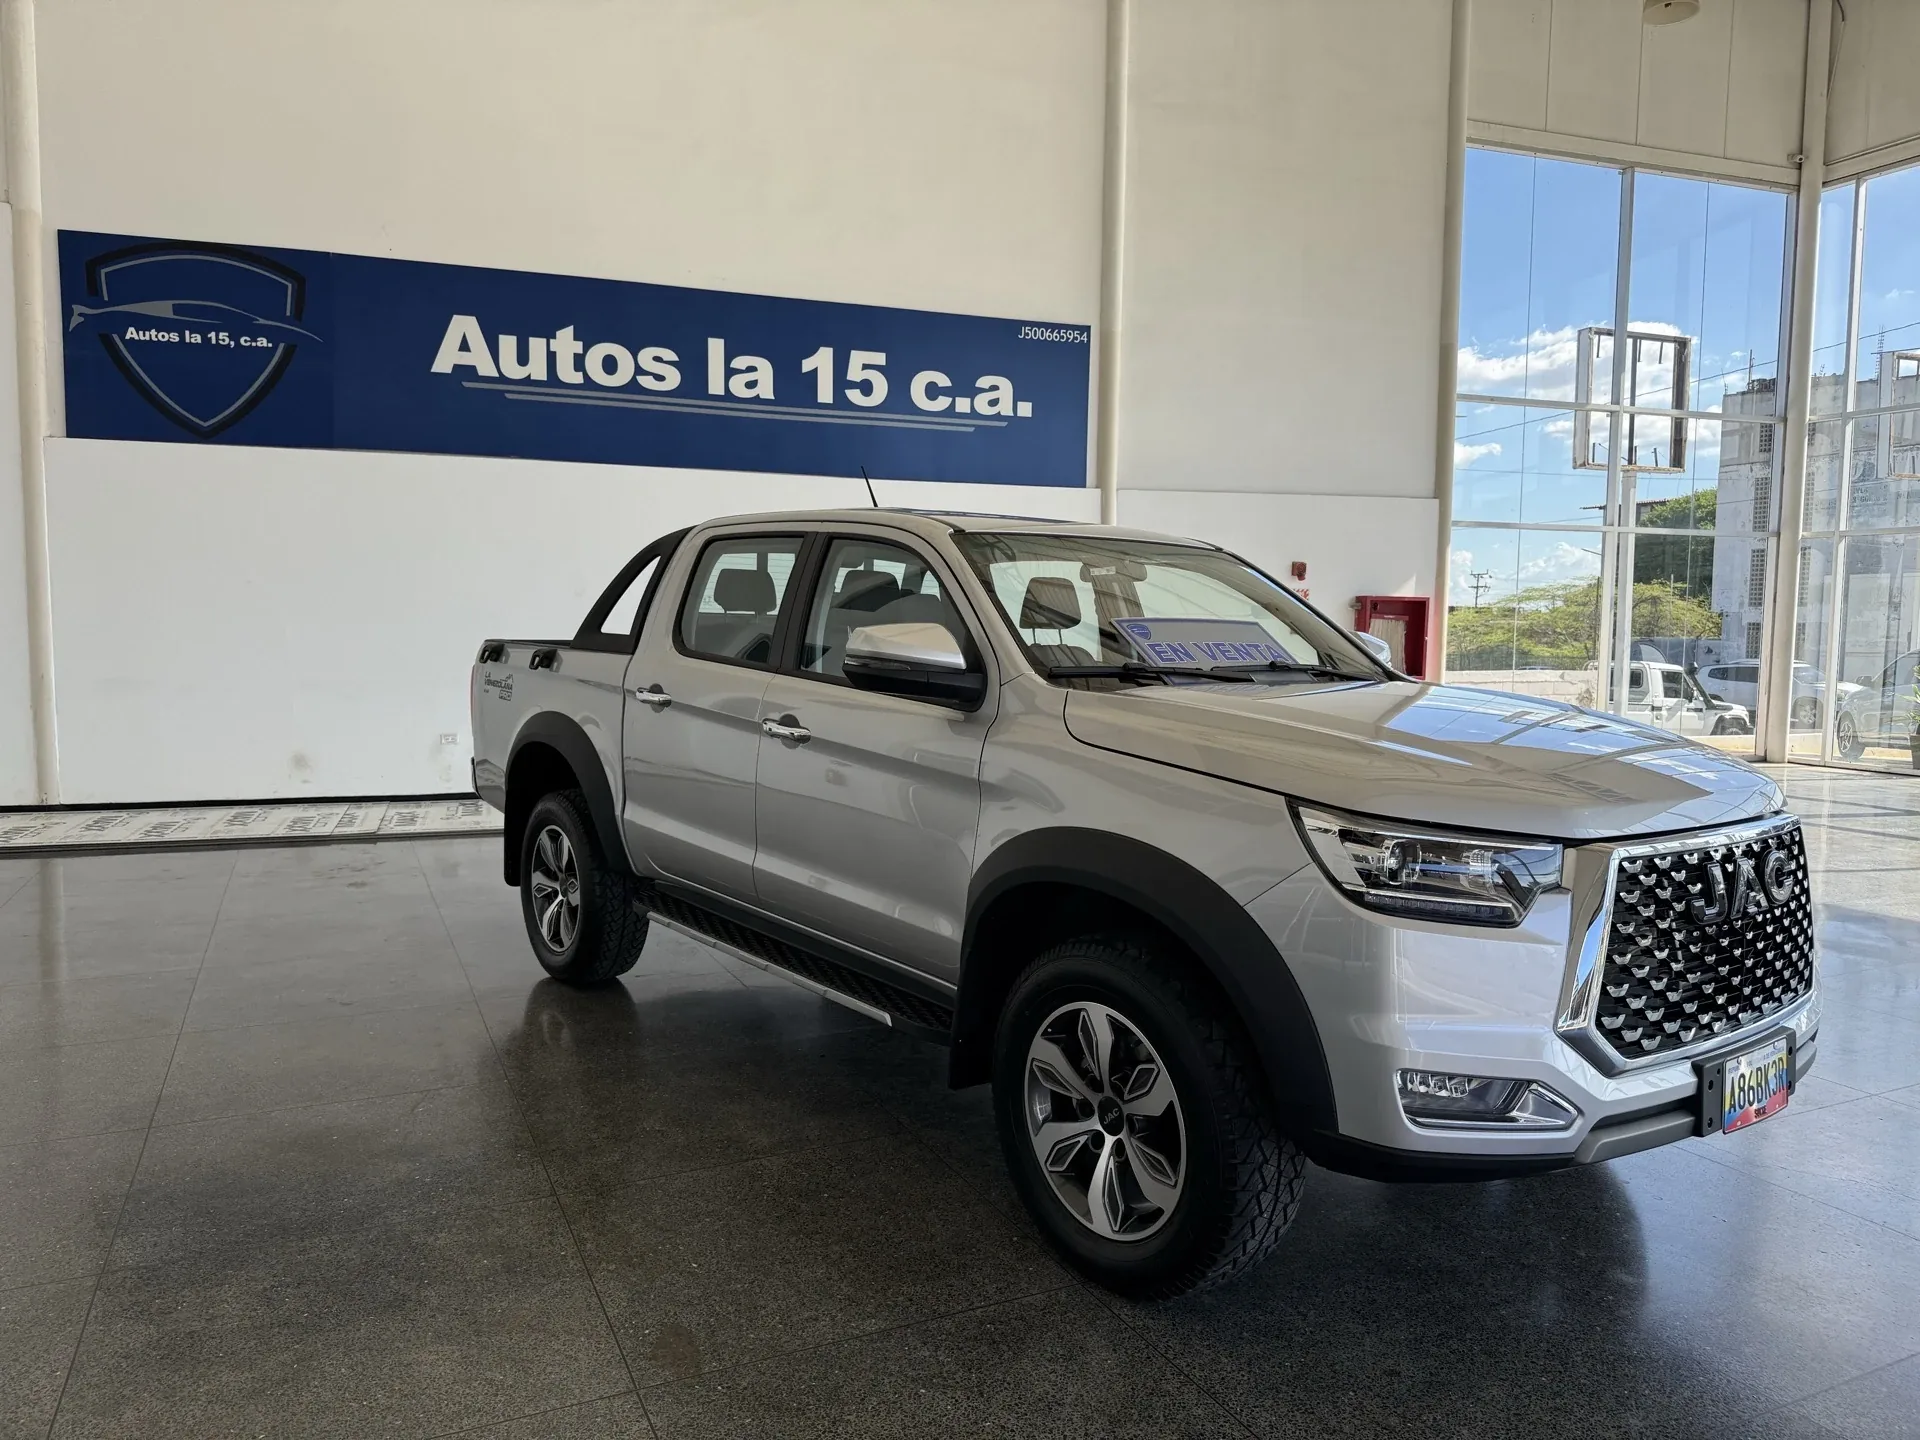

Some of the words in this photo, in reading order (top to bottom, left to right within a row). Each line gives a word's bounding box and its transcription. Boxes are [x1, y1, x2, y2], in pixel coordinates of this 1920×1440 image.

[125, 326, 180, 343] Autos
[184, 330, 202, 344] la
[207, 331, 235, 348] 15,
[239, 336, 273, 348] c.a.
[1018, 326, 1088, 344] J500665954
[430, 314, 682, 391] Autos
[707, 337, 775, 400] la
[801, 346, 889, 407] 15
[910, 370, 1033, 418] c.a.
[1145, 642, 1198, 663] EN
[1190, 642, 1291, 663] VENTA
[1691, 849, 1795, 925] JAC
[1729, 1057, 1785, 1114] A86BK3R
[1103, 1108, 1120, 1125] JAC
